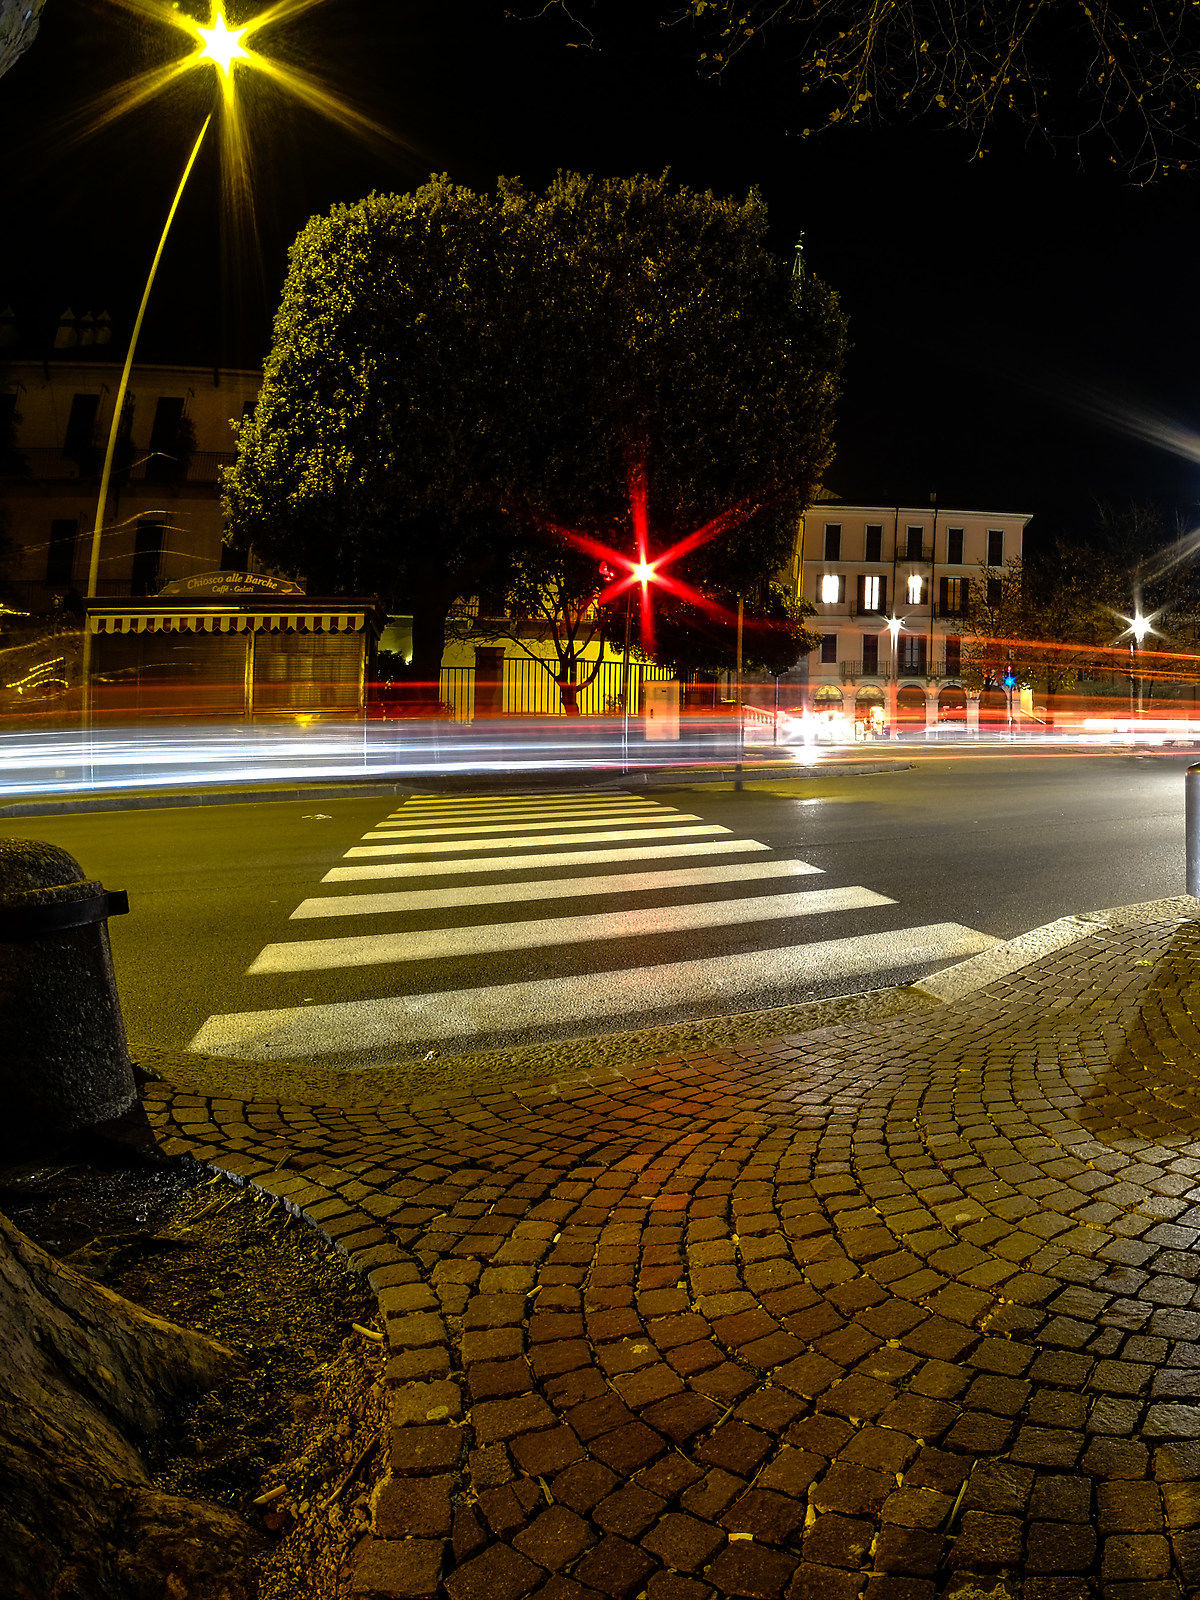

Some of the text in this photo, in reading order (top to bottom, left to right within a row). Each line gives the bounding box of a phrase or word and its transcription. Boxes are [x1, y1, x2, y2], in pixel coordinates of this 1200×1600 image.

[187, 573, 278, 589] Chiosco alle Barche
[234, 585, 254, 593] Gelati
